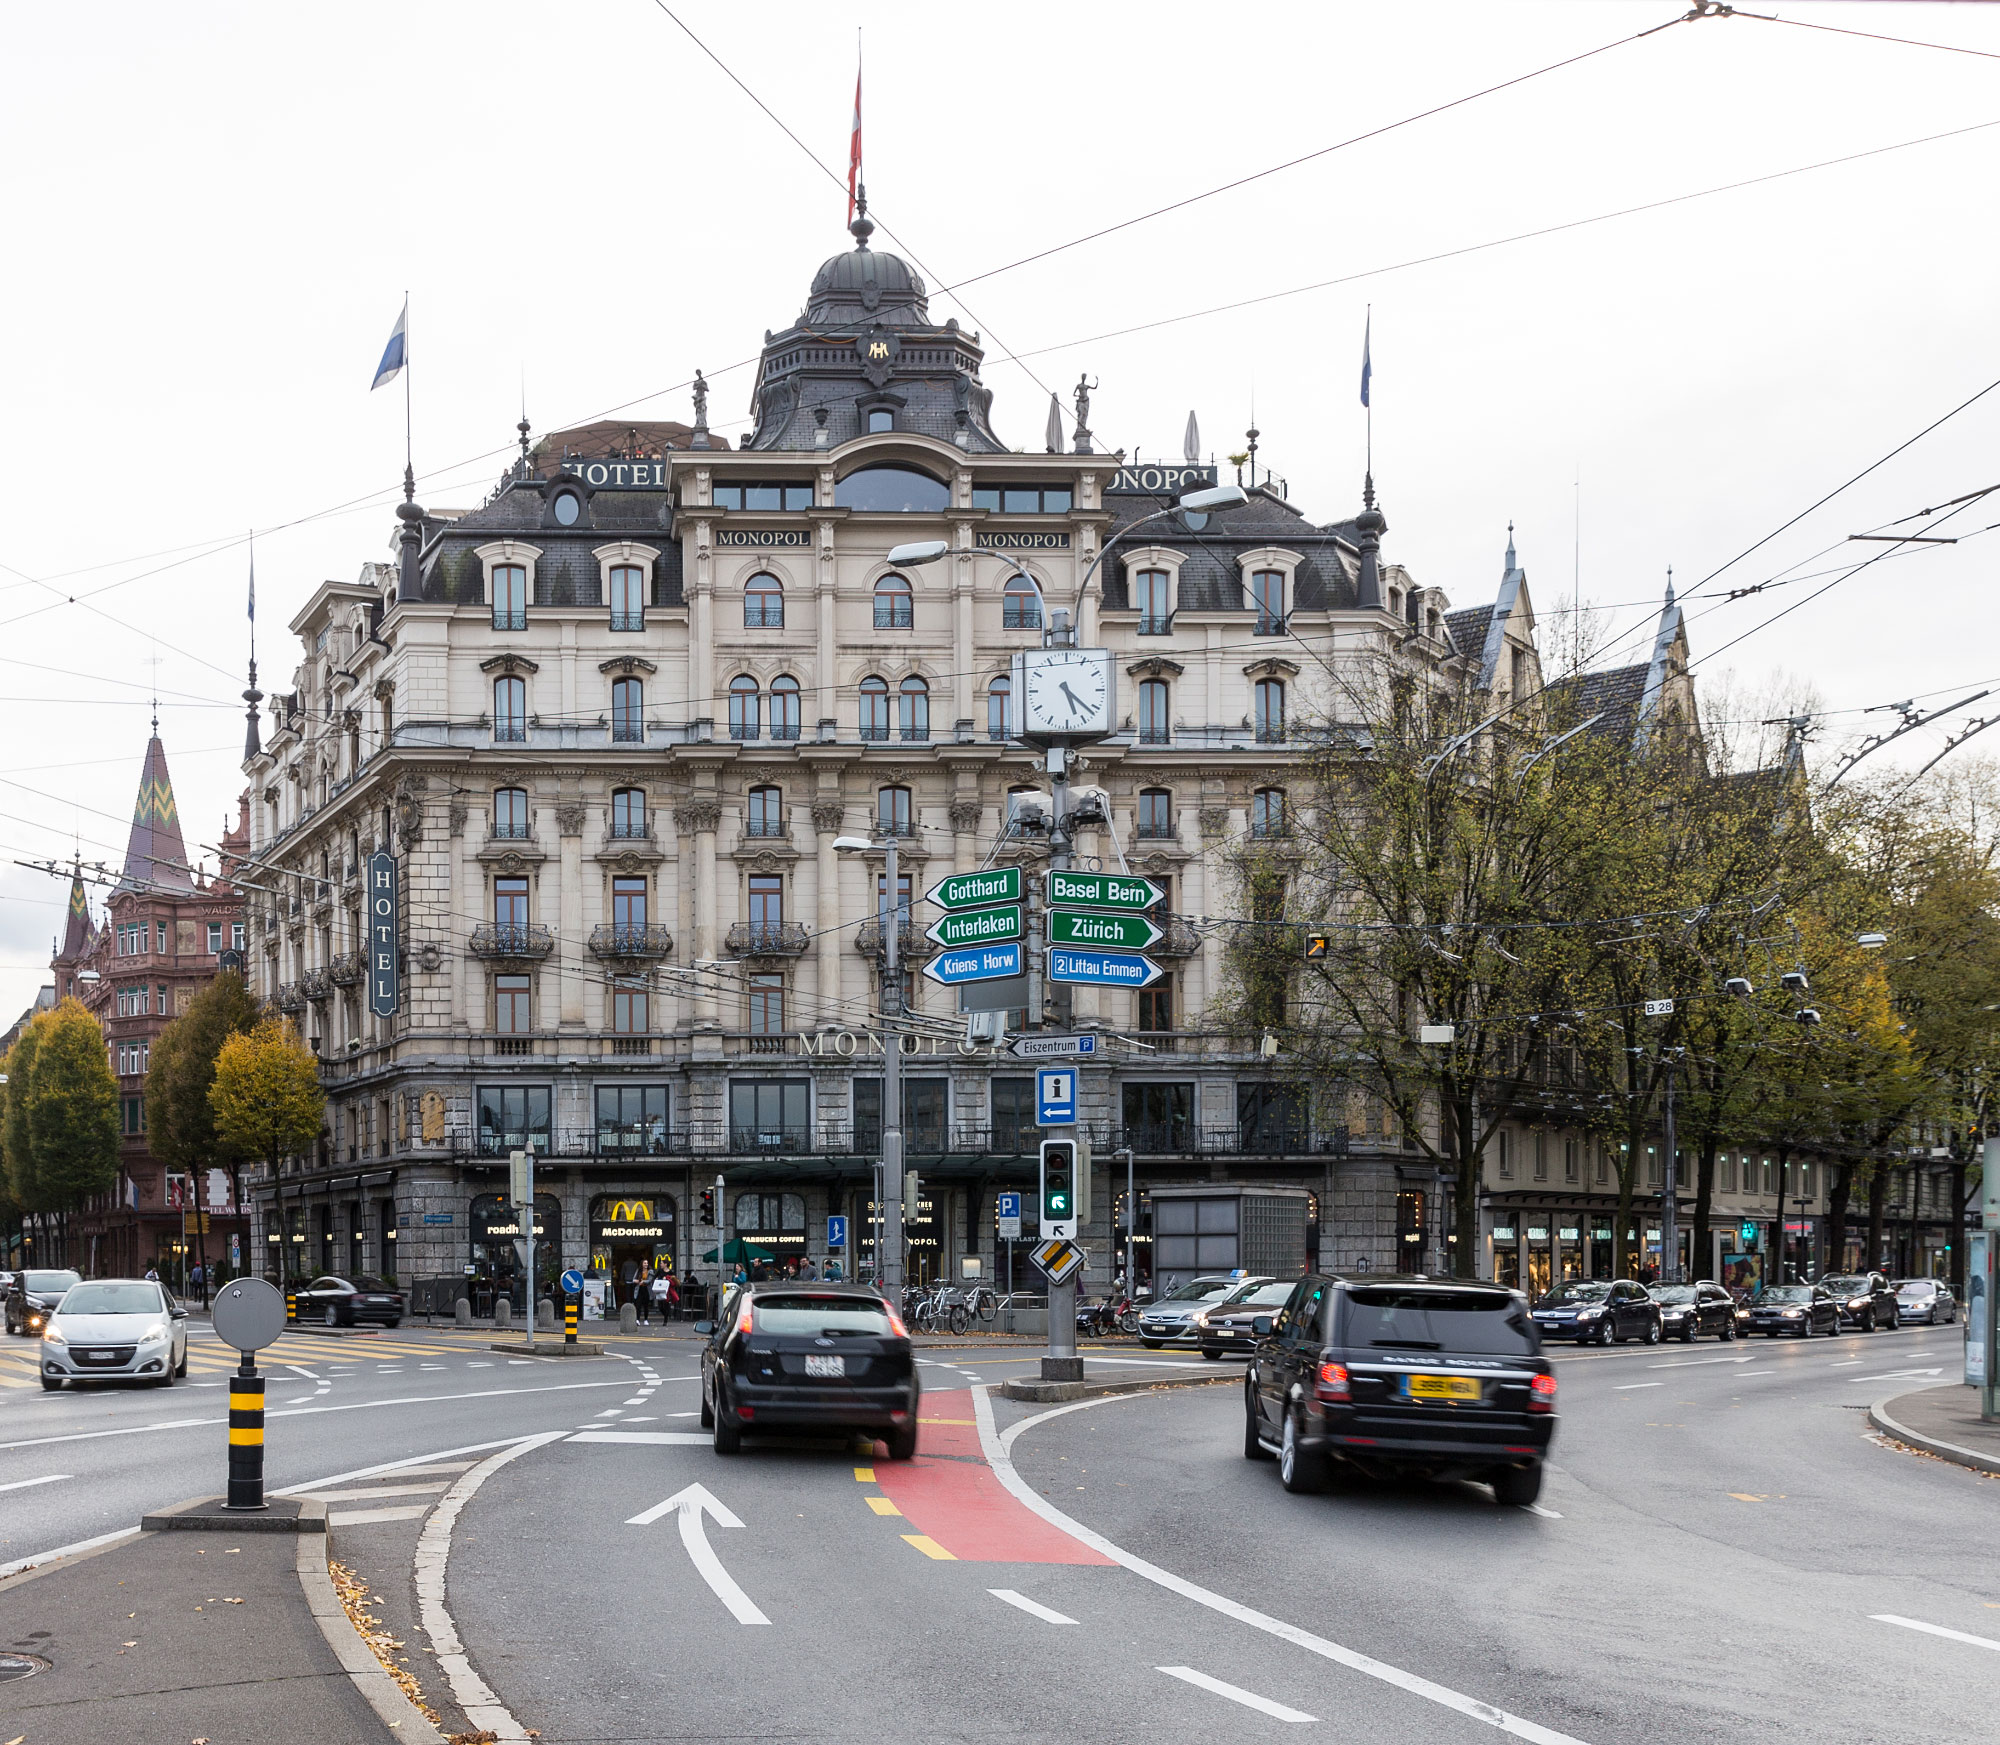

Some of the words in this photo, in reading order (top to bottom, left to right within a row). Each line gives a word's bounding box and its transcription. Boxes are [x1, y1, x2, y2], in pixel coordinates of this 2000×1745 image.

[719, 532, 809, 545] MONOPOL
[978, 534, 1068, 547] MONOPOL
[949, 875, 1008, 900] Gotthard
[1054, 878, 1100, 899] Basel
[1108, 882, 1145, 902] Bern
[375, 871, 392, 998] HOTEL
[946, 915, 1015, 939] Interlaken
[1071, 918, 1124, 940] Zürich
[944, 959, 978, 975] Kriens
[983, 953, 1014, 970] Horw
[1057, 959, 1065, 972] 2
[1069, 958, 1100, 975] Littau
[1103, 961, 1142, 978] Emmen
[1647, 1004, 1655, 1013] B
[1658, 1002, 1672, 1011] 28
[1024, 1041, 1076, 1053] Eiszentrum
[1002, 1198, 1012, 1214] P
[602, 1227, 663, 1236] McDonald's
